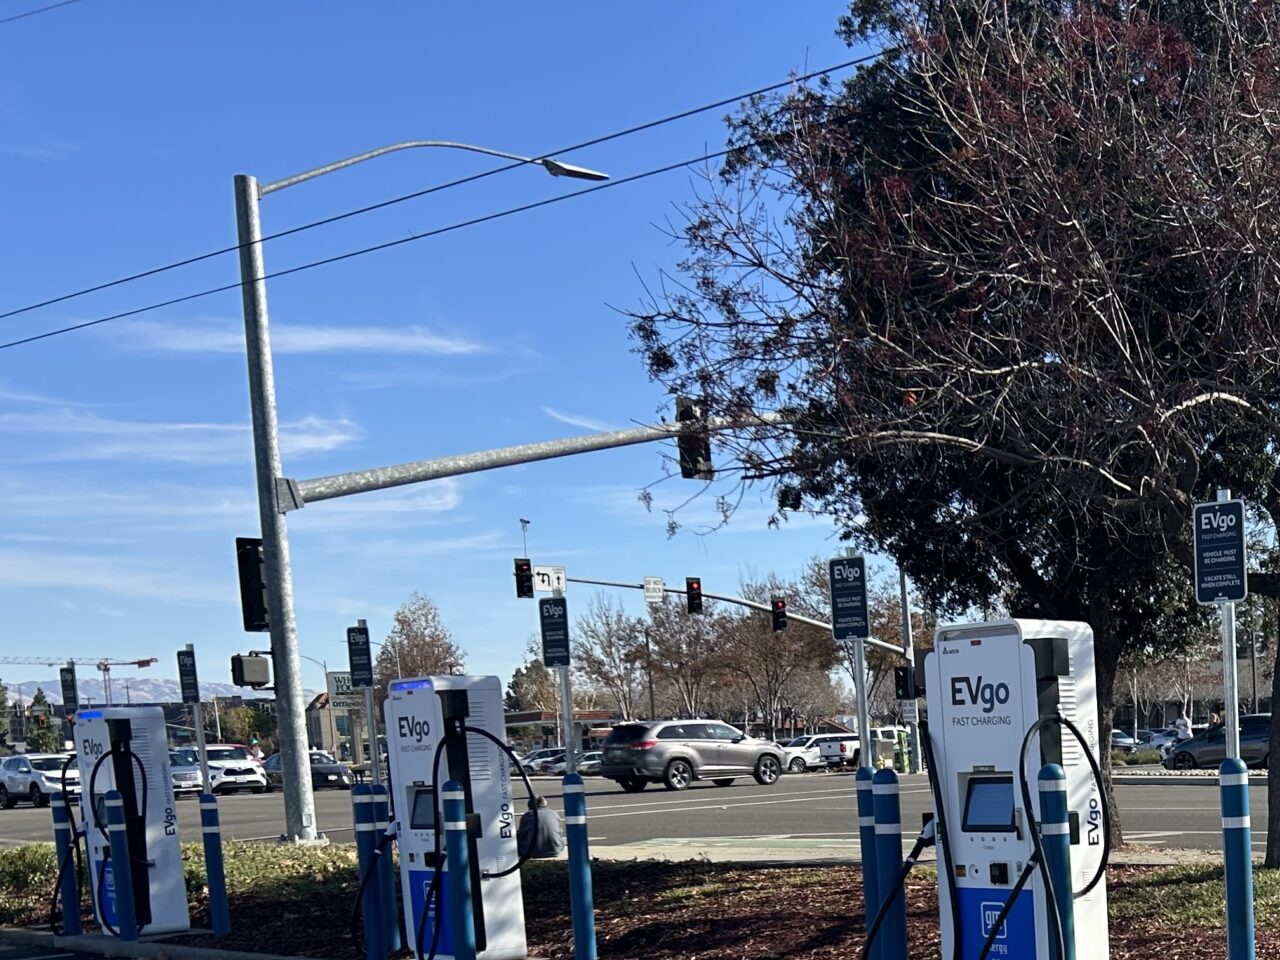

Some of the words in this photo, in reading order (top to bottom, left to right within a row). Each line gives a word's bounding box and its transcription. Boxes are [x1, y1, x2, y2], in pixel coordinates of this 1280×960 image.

[1201, 511, 1236, 531] EVgo
[834, 564, 860, 581] EVgo
[543, 604, 564, 618] EVgo
[951, 676, 1010, 713] EVgo
[398, 716, 430, 742] EVgo
[952, 716, 970, 727] FAST
[971, 715, 1012, 726] CHARGING
[83, 738, 103, 760] EVgo
[164, 807, 176, 836] EVgo
[499, 803, 513, 839] EVgo
[1087, 798, 1101, 846] EVgo
[989, 943, 1008, 955] ergy
